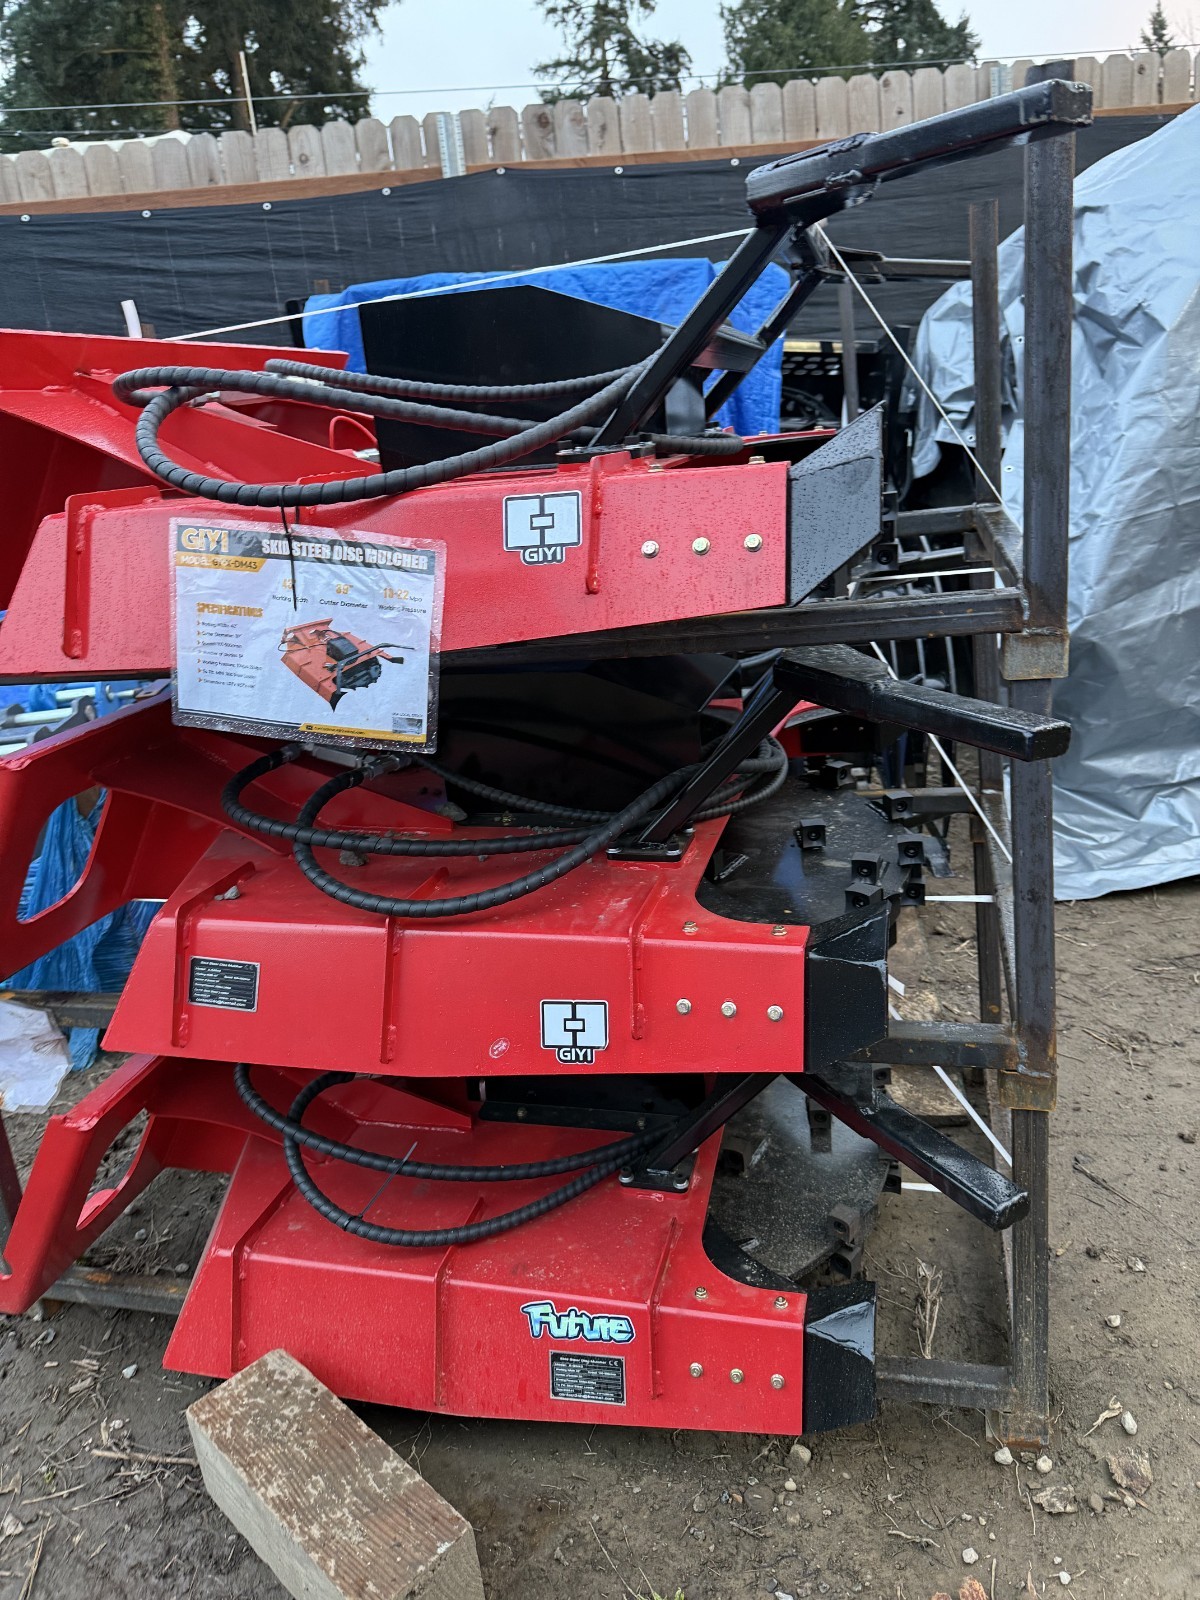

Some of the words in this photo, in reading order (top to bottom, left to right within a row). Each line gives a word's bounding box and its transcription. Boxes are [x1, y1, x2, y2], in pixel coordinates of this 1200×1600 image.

[181, 527, 229, 553] GIYI
[261, 539, 291, 555] SKID
[291, 541, 331, 560] STEER
[332, 545, 364, 563] DISC
[365, 548, 429, 571] MULCHER
[524, 546, 562, 562] GIYI
[319, 598, 339, 607] Cutter
[340, 600, 369, 610] Diameter
[559, 1048, 592, 1061] GIYI
[521, 1301, 635, 1344] Future
